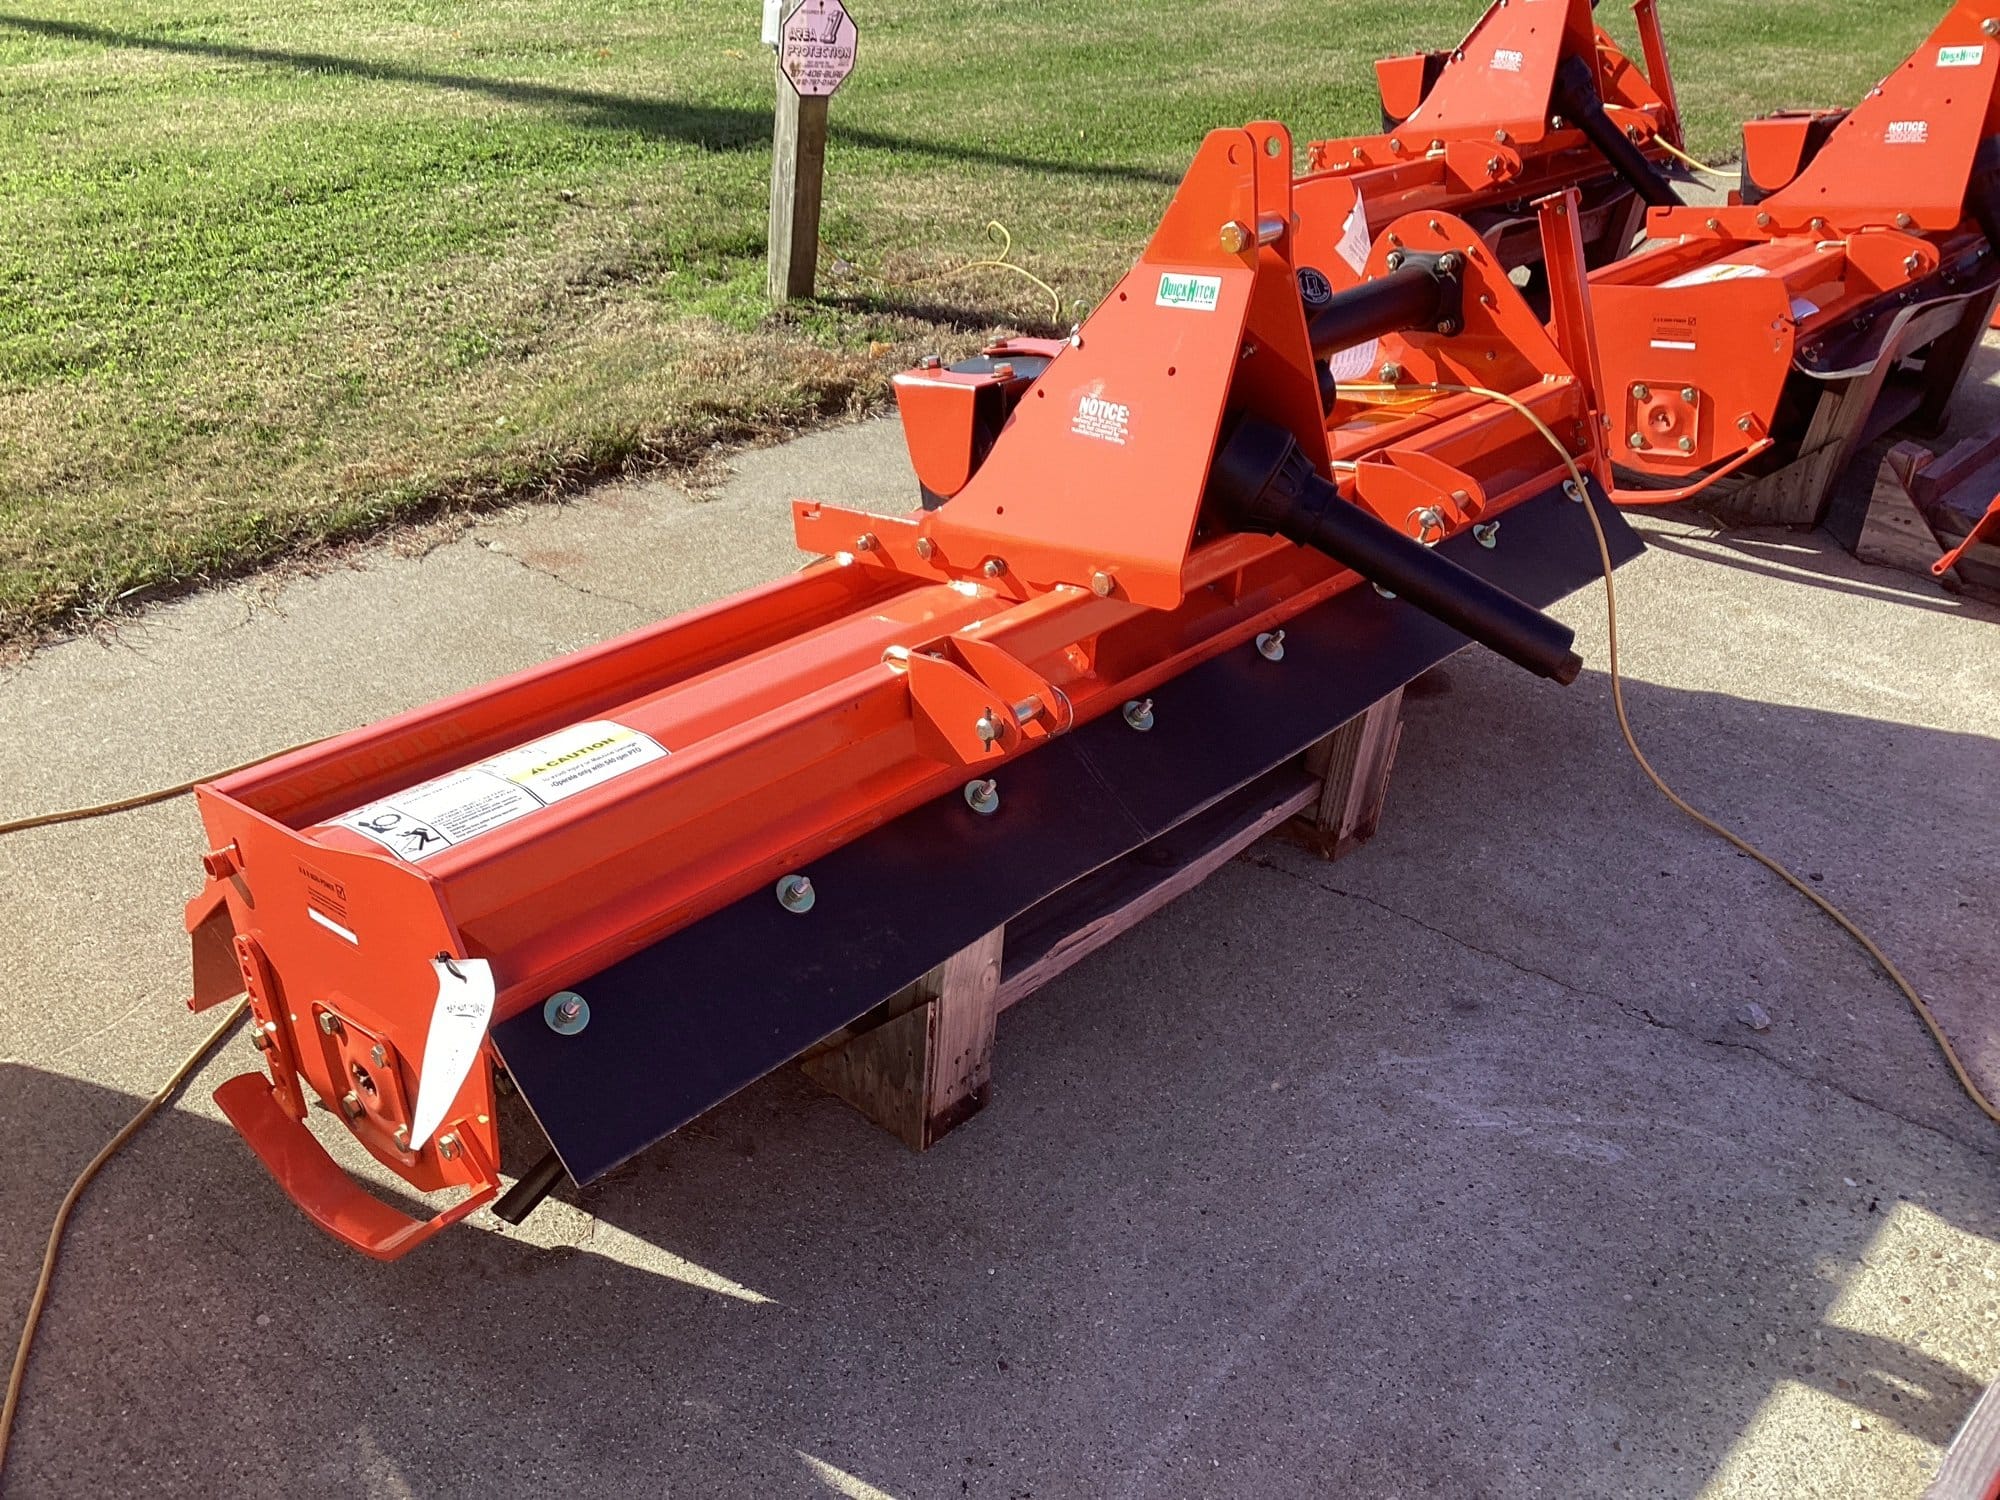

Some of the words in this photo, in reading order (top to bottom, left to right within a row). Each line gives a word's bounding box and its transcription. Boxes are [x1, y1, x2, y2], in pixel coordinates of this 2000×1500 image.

[788, 27, 818, 42] AREA
[787, 45, 851, 59] PROTECTION
[1079, 396, 1130, 424] NOTICE:
[546, 737, 616, 768] CAUTION
